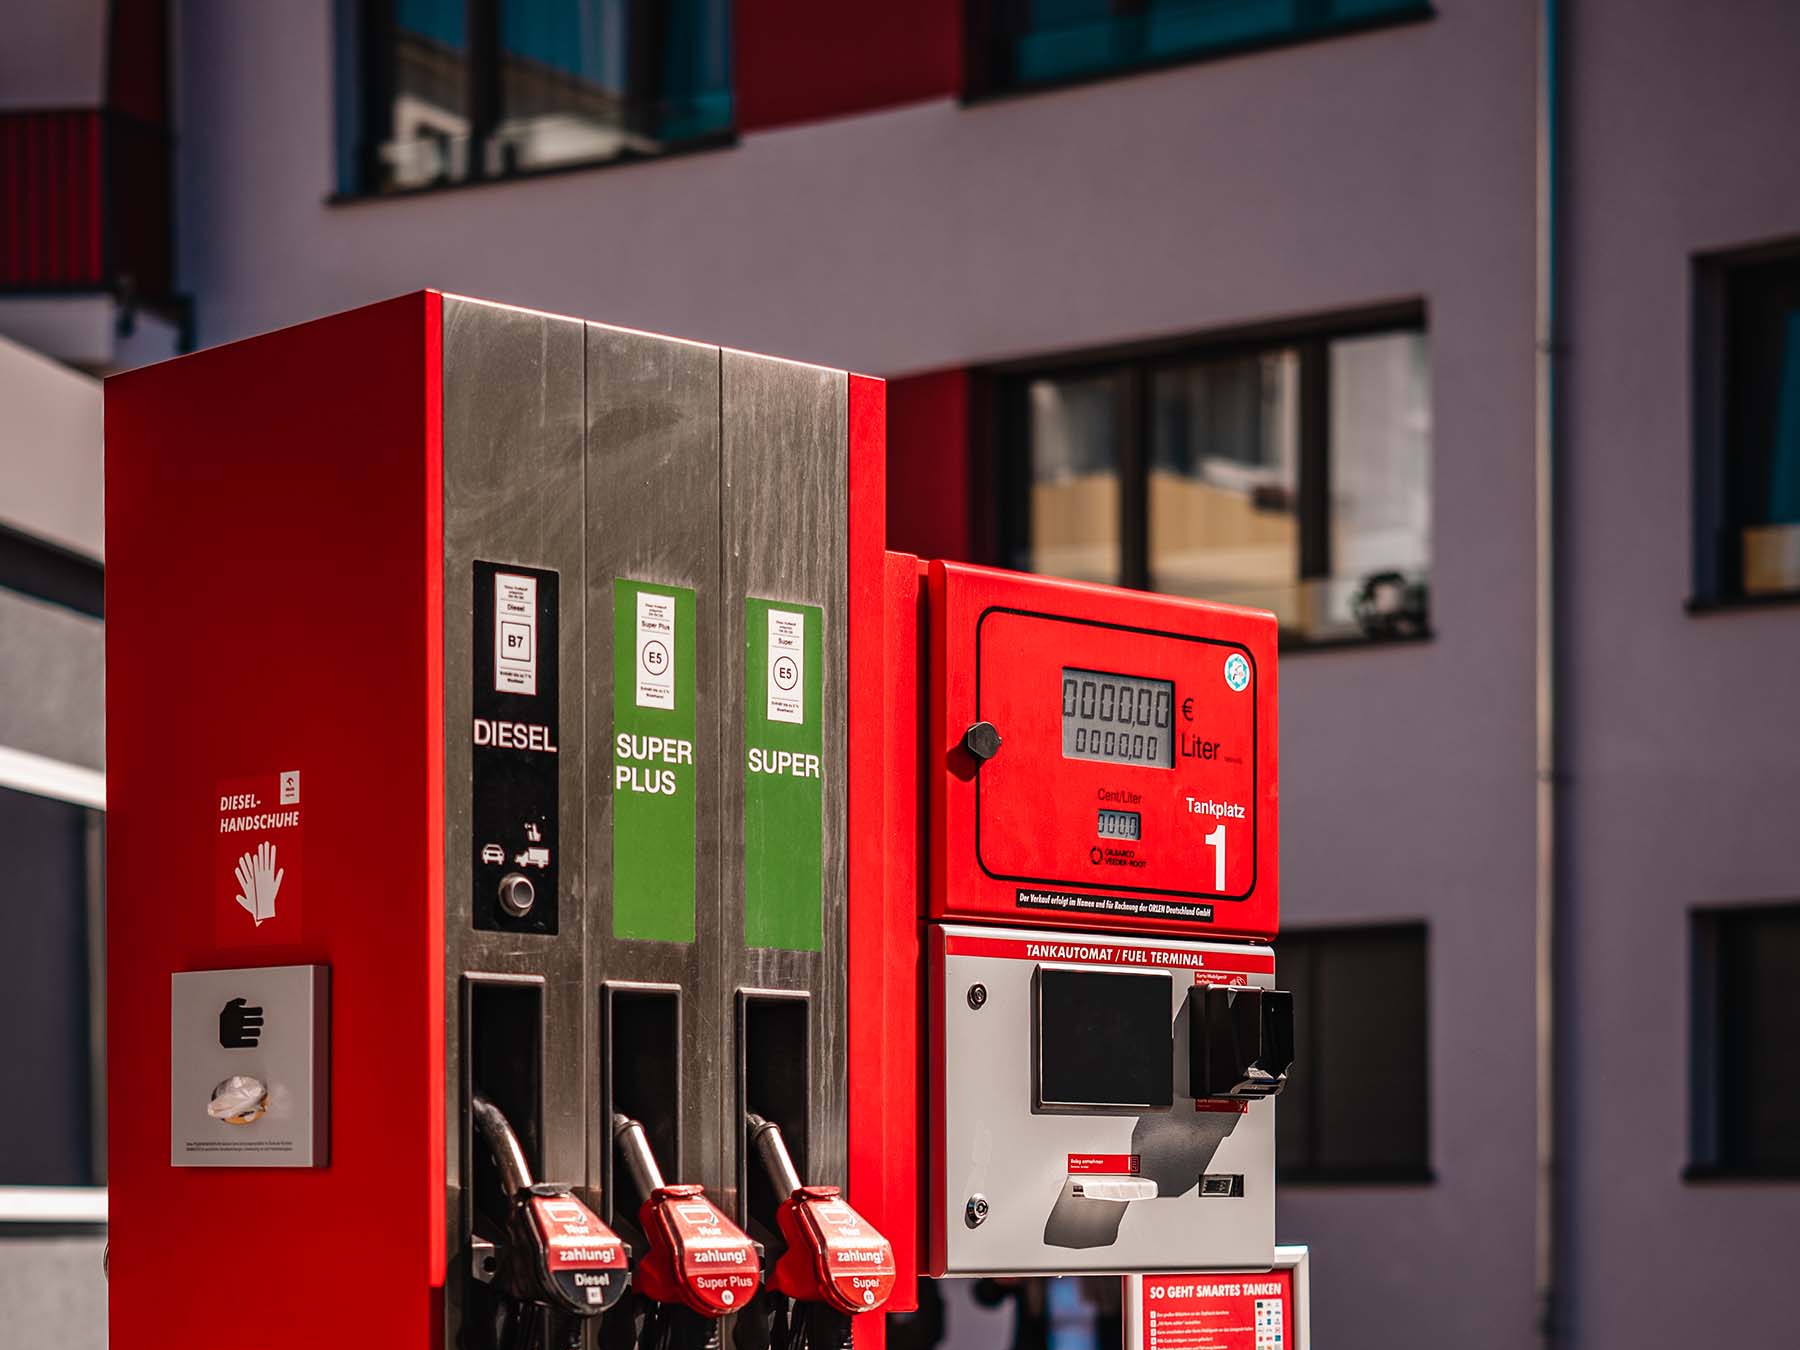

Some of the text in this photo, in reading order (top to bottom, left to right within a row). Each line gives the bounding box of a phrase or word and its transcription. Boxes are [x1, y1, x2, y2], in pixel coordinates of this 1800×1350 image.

[508, 634, 523, 648] B7
[649, 651, 662, 665] E5
[779, 667, 792, 680] E5
[1181, 697, 1195, 722] €
[473, 718, 558, 753] DIESEL
[616, 732, 693, 766] SUPER
[1181, 733, 1221, 761] Liter
[748, 747, 820, 779] SUPER
[615, 765, 676, 796] PLUS
[220, 793, 261, 812] DIESEL-
[1097, 787, 1142, 806] Cent/Liter
[1186, 796, 1246, 820] Tankplatz
[220, 811, 300, 834] HANDSCHUHE
[1204, 824, 1226, 892] 1
[1030, 893, 1051, 905] Verkauf
[1050, 895, 1069, 908] erfolgt
[1076, 897, 1095, 909] Namen
[1114, 900, 1138, 914] Rechnung
[1148, 904, 1166, 913] ORLEN
[1166, 905, 1195, 916] Deutschland
[1026, 944, 1112, 960] TANKAUTOMAT
[1122, 949, 1147, 963] FUEL
[1150, 951, 1204, 967] TERMINAL
[559, 1247, 616, 1264] zahlung!
[694, 1249, 747, 1264] zahlung!
[836, 1249, 884, 1264] zahlung!
[574, 1272, 610, 1287] Diesel
[696, 1275, 753, 1291] Super Plus
[852, 1277, 880, 1291] Super
[1150, 1282, 1282, 1299] SO GEHT SMARTES TANKEN
